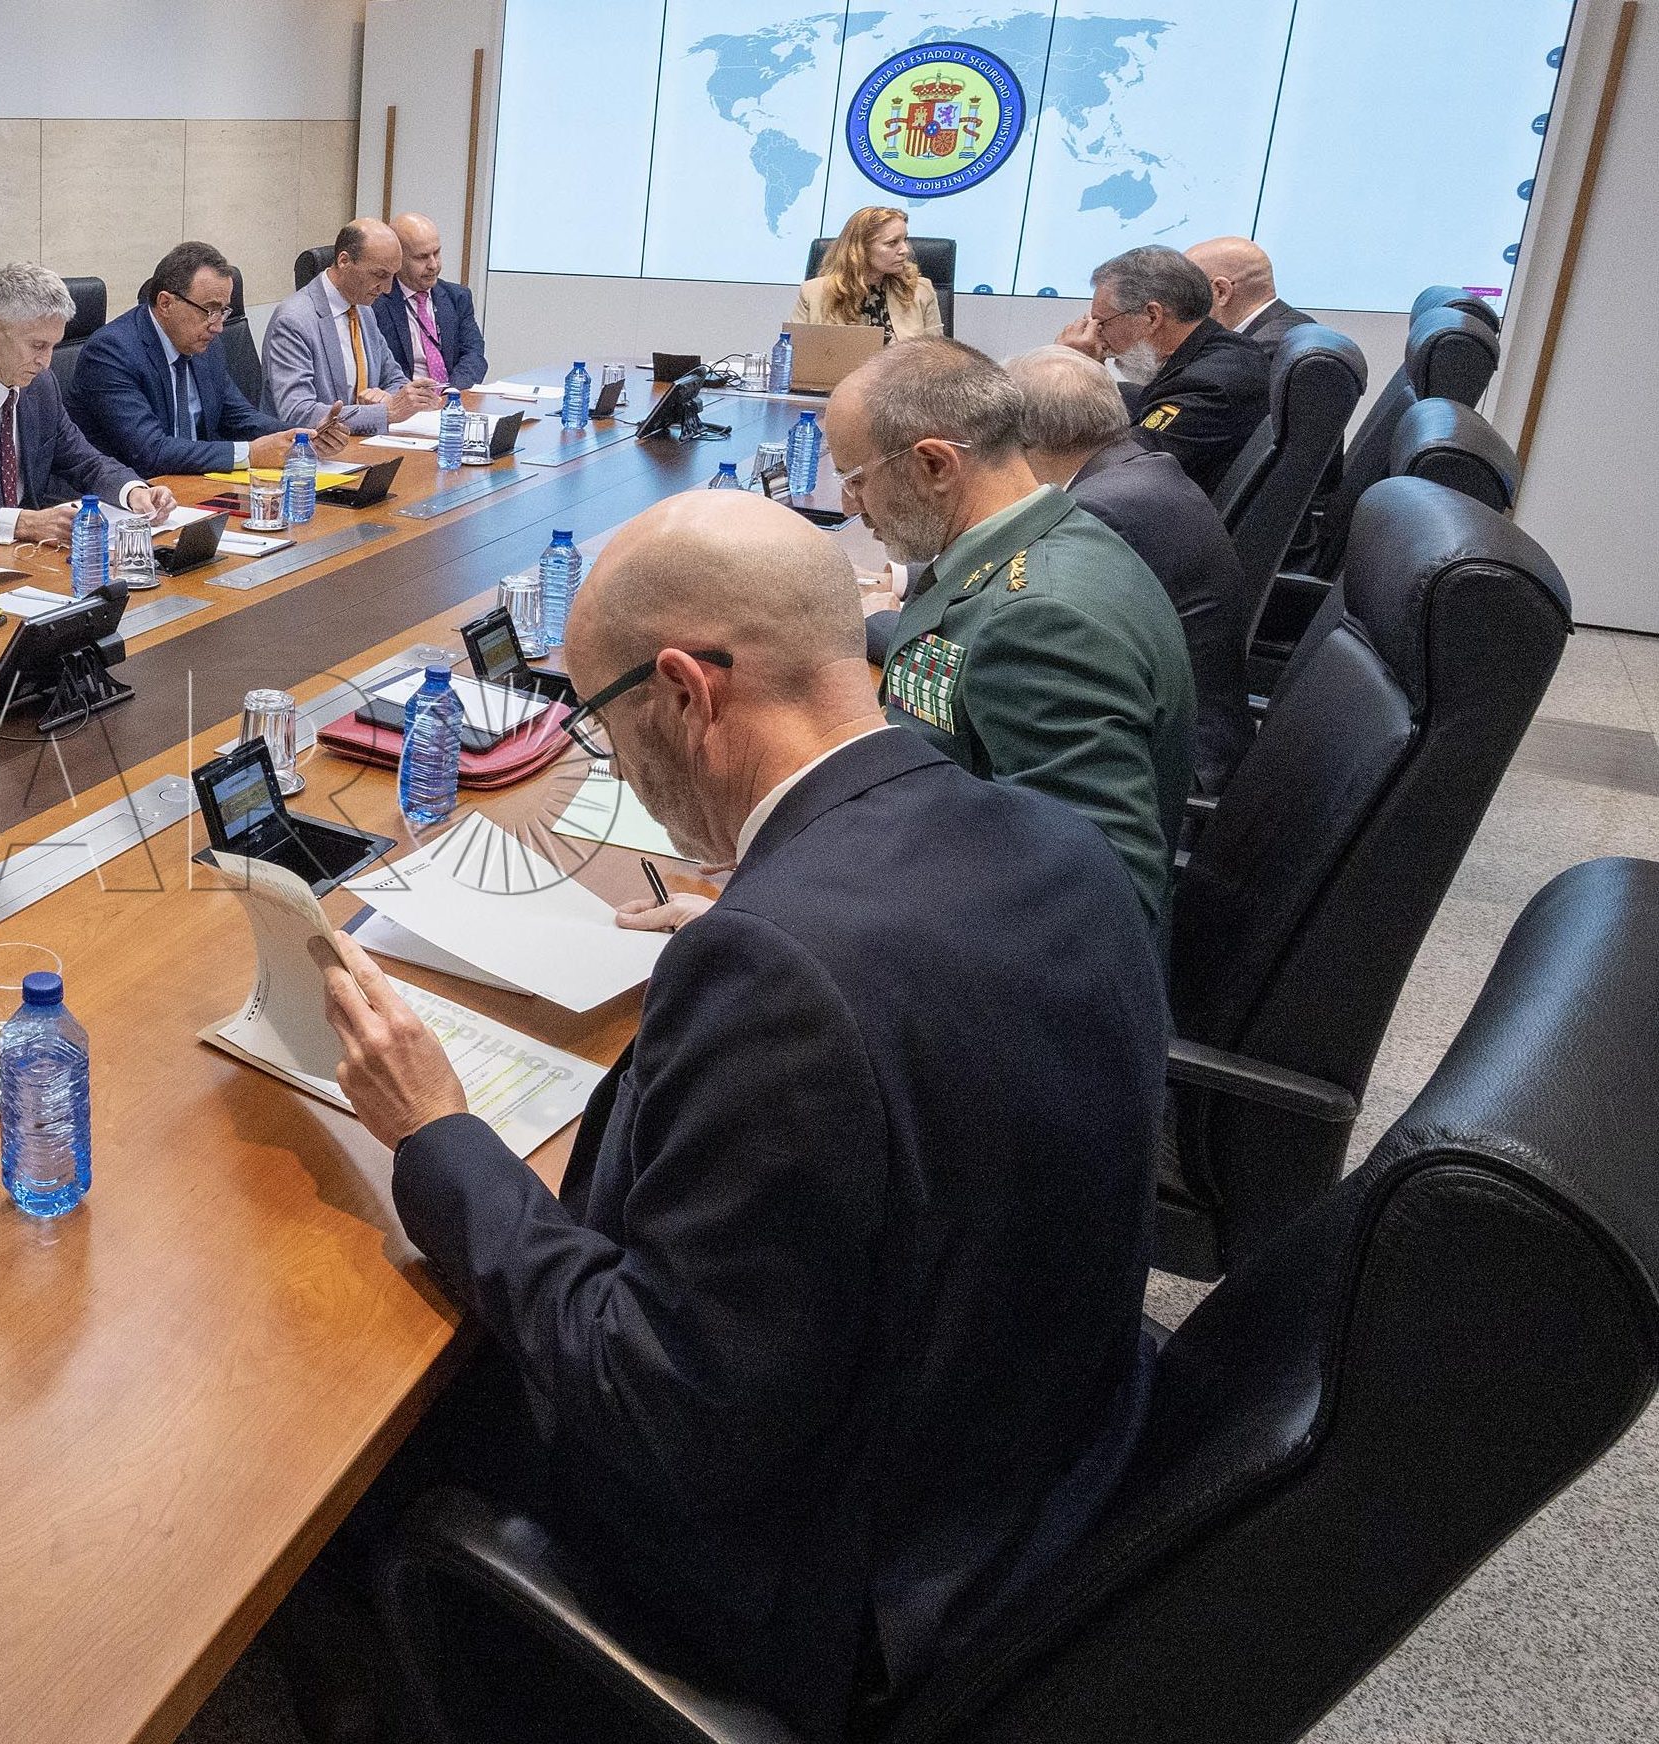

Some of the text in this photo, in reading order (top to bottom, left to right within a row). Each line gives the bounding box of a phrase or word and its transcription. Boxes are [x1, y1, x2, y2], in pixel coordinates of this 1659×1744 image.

[894, 60, 908, 72] DE
[910, 50, 951, 64] ESTADO
[953, 51, 968, 60] DE
[968, 55, 1010, 99] SEGURIDAD
[857, 135, 906, 187] SALA DE CRISIS
[915, 106, 1014, 190] MINISTERIO DEL INTERIOR
